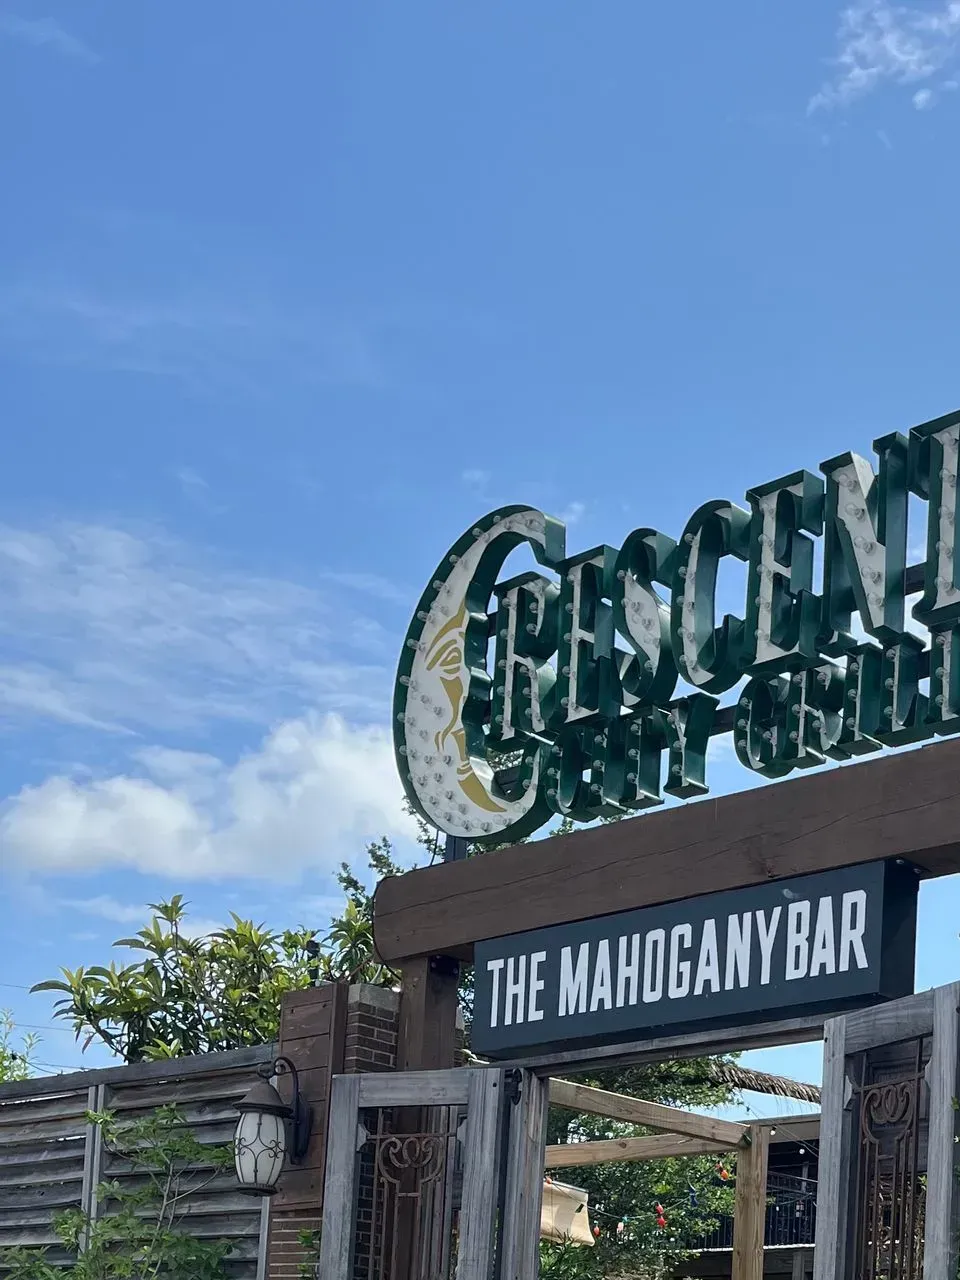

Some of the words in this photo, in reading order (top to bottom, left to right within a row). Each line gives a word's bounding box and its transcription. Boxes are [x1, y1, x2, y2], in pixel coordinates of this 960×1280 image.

[544, 692, 720, 822] CITY
[487, 950, 547, 1028] THE
[557, 905, 783, 1017] MAHOGANY
[785, 889, 869, 981] BAR
